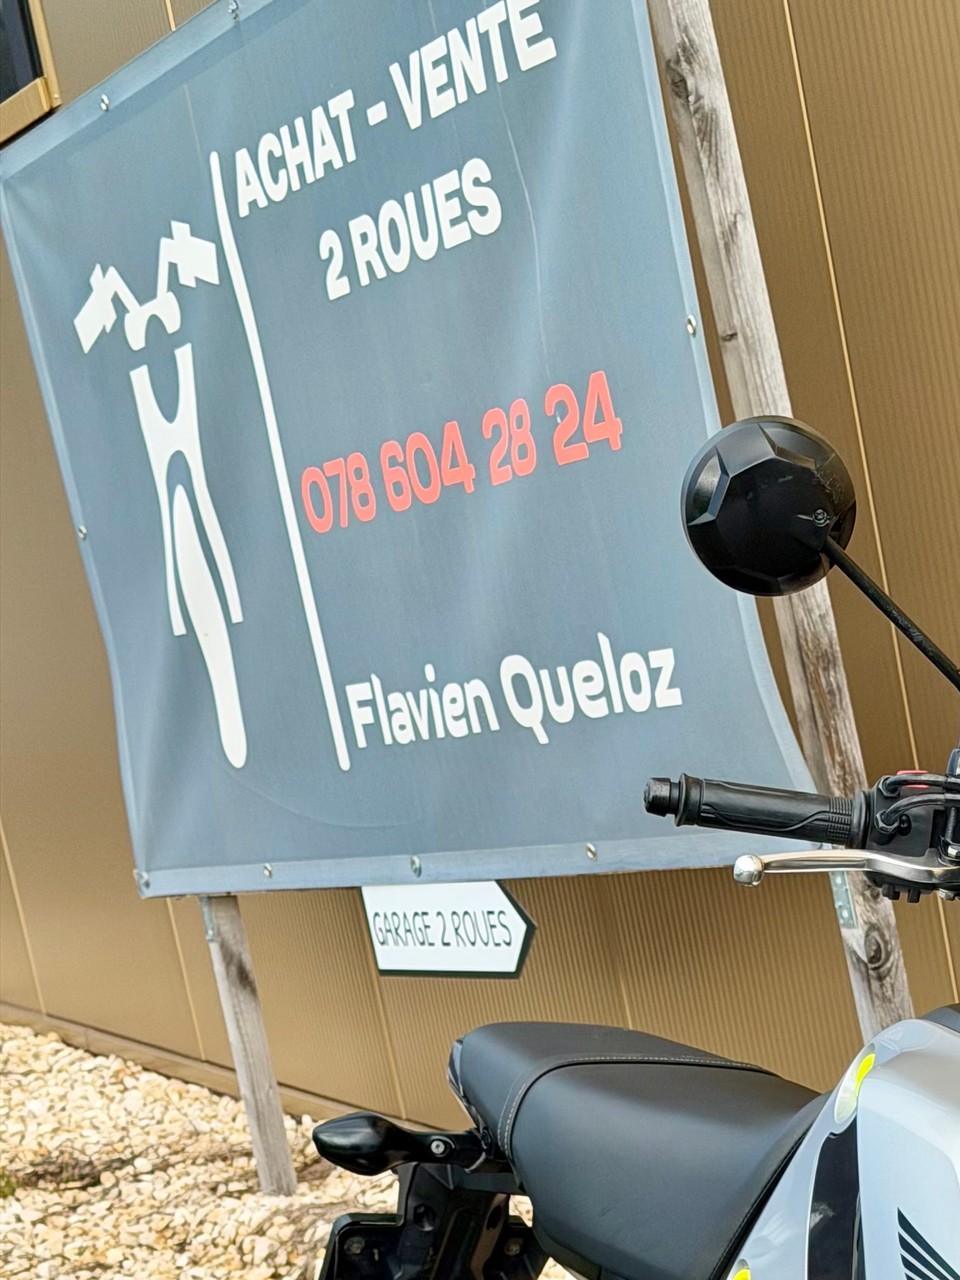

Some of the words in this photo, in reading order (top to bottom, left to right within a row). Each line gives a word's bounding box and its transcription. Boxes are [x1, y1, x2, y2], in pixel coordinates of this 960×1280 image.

[235, 89, 358, 218] ACHAT
[388, 0, 557, 130] VENTE
[319, 229, 351, 301] 2
[348, 157, 502, 287] ROUES
[301, 452, 376, 534] 078
[380, 421, 475, 512] 604
[482, 399, 537, 486] 28
[544, 371, 623, 465] 24
[345, 663, 500, 748] Flavien
[500, 632, 683, 745] Queloz
[373, 911, 435, 947] GARAGE
[436, 910, 451, 947] 2
[451, 910, 512, 948] ROUES
